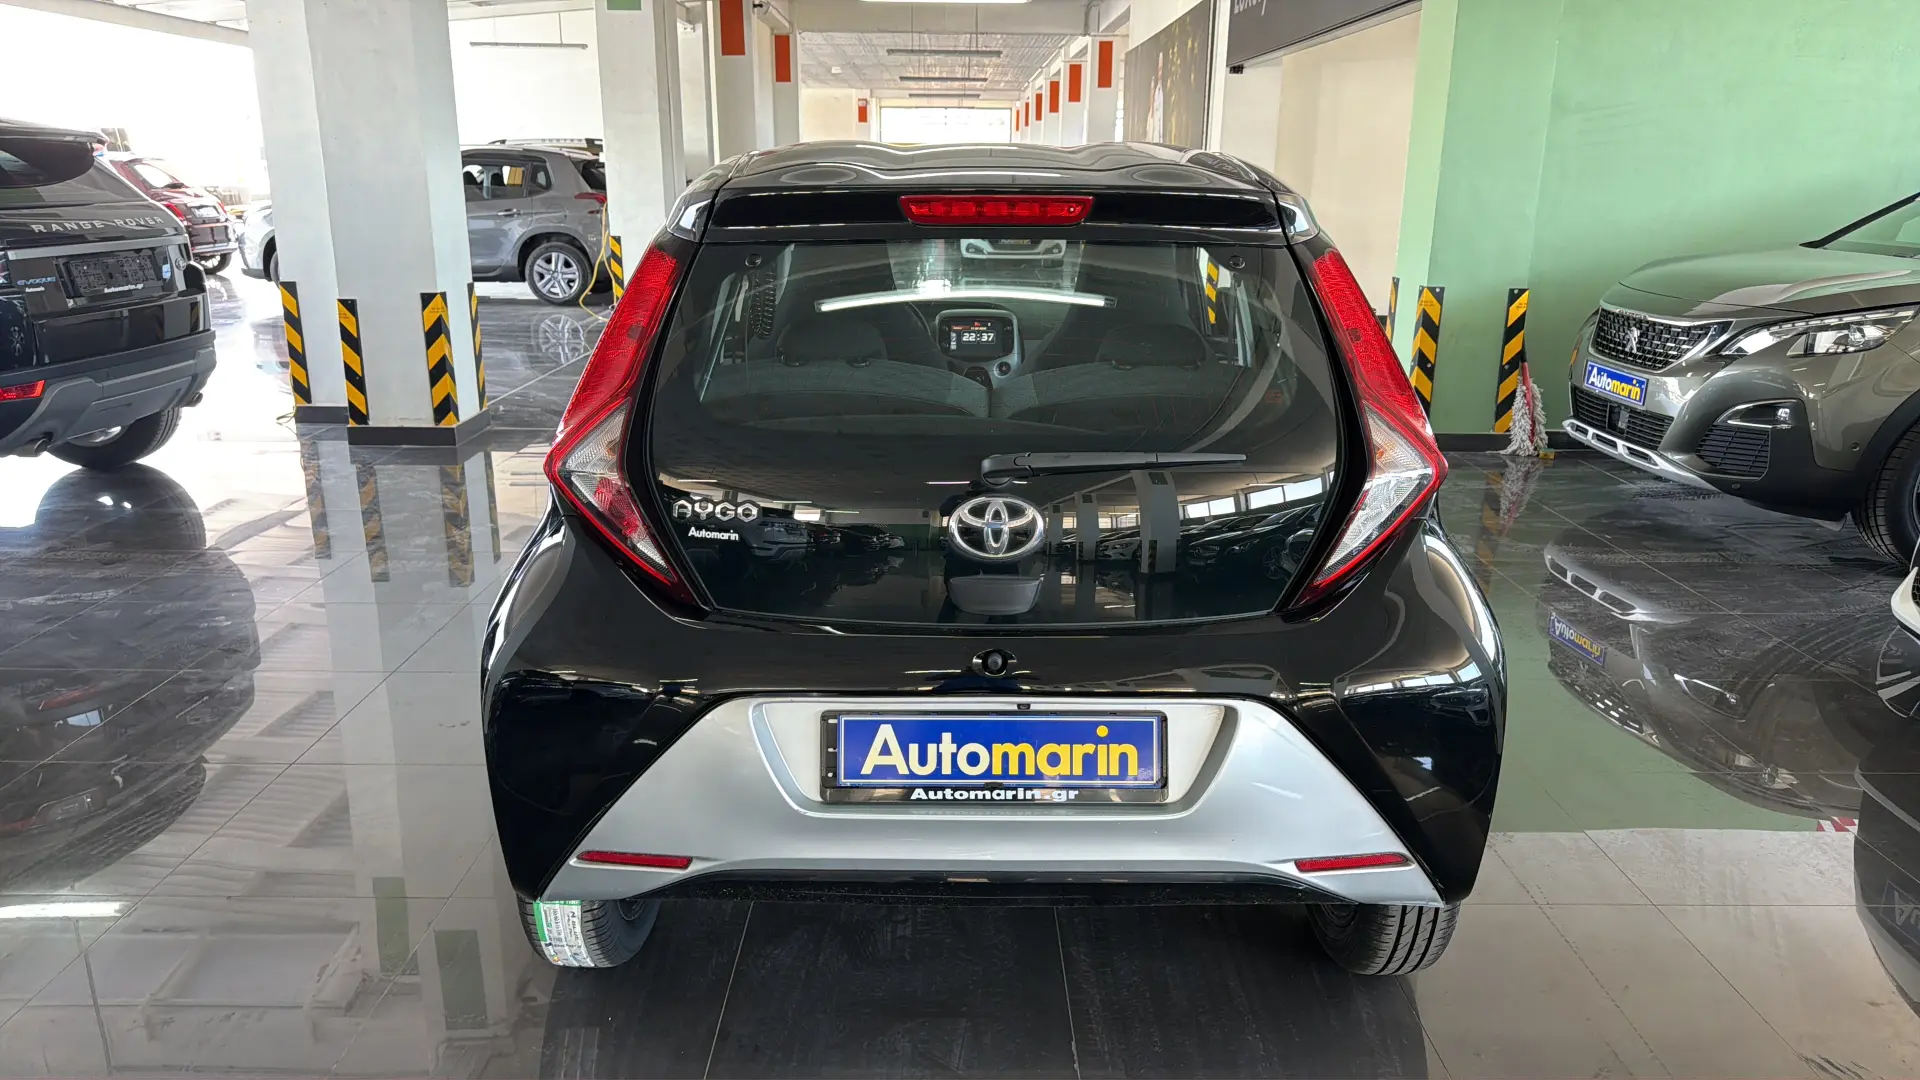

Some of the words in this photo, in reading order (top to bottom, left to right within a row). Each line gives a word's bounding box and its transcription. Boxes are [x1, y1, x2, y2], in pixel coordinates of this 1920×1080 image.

[30, 220, 105, 233] RANGE
[114, 216, 164, 227] ROVER
[962, 332, 995, 342] 22:37
[1588, 366, 1641, 401] Automarin
[672, 499, 758, 522] AYGO
[688, 526, 739, 541] Automarin
[860, 723, 1138, 776] Automarin
[910, 787, 1079, 802] Automarin.gr
